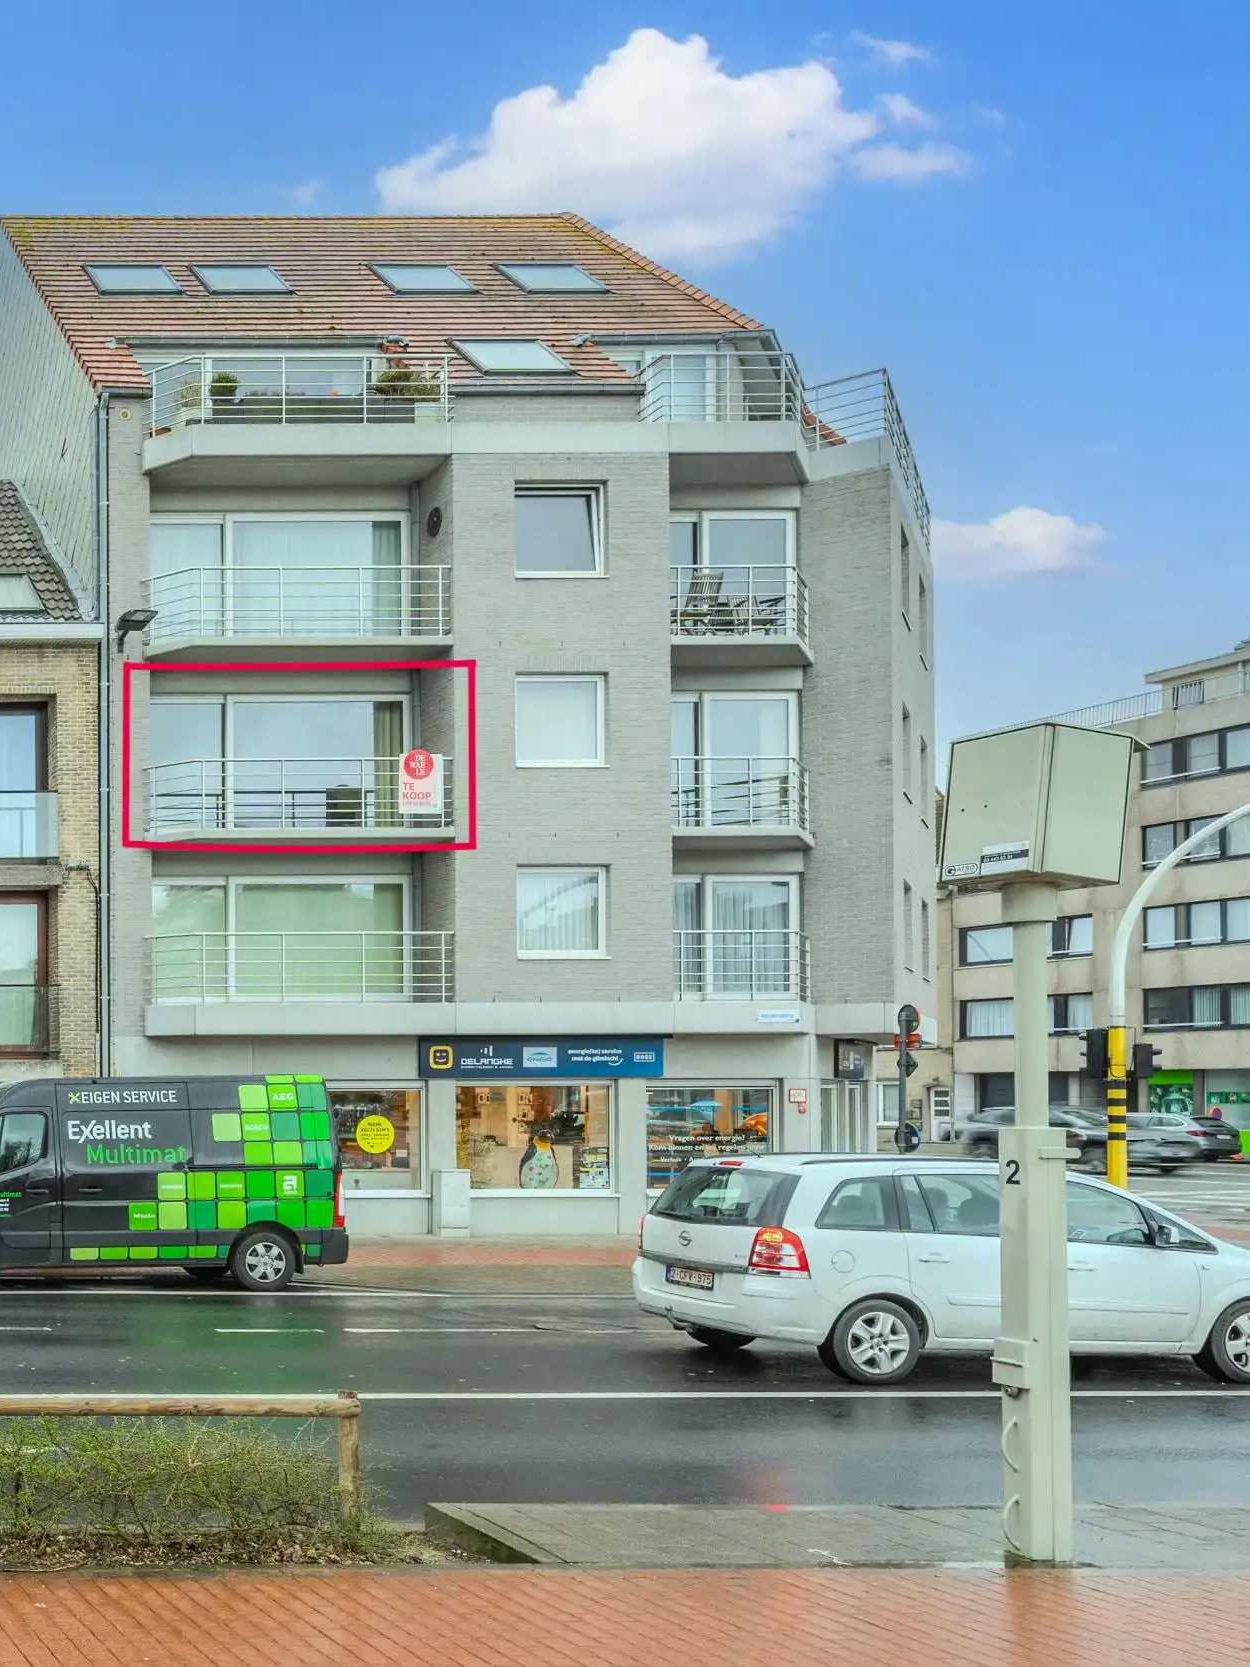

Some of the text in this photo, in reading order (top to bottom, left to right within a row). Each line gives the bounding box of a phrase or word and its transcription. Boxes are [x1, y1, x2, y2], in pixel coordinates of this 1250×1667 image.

[415, 754, 426, 762] DE
[403, 782, 415, 791] TE
[403, 791, 432, 800] KOOP
[81, 1090, 178, 1104] EIGEN SERVICE
[271, 1092, 294, 1101] AEG
[86, 1143, 187, 1165] Multimat
[1005, 1159, 1021, 1185] 2
